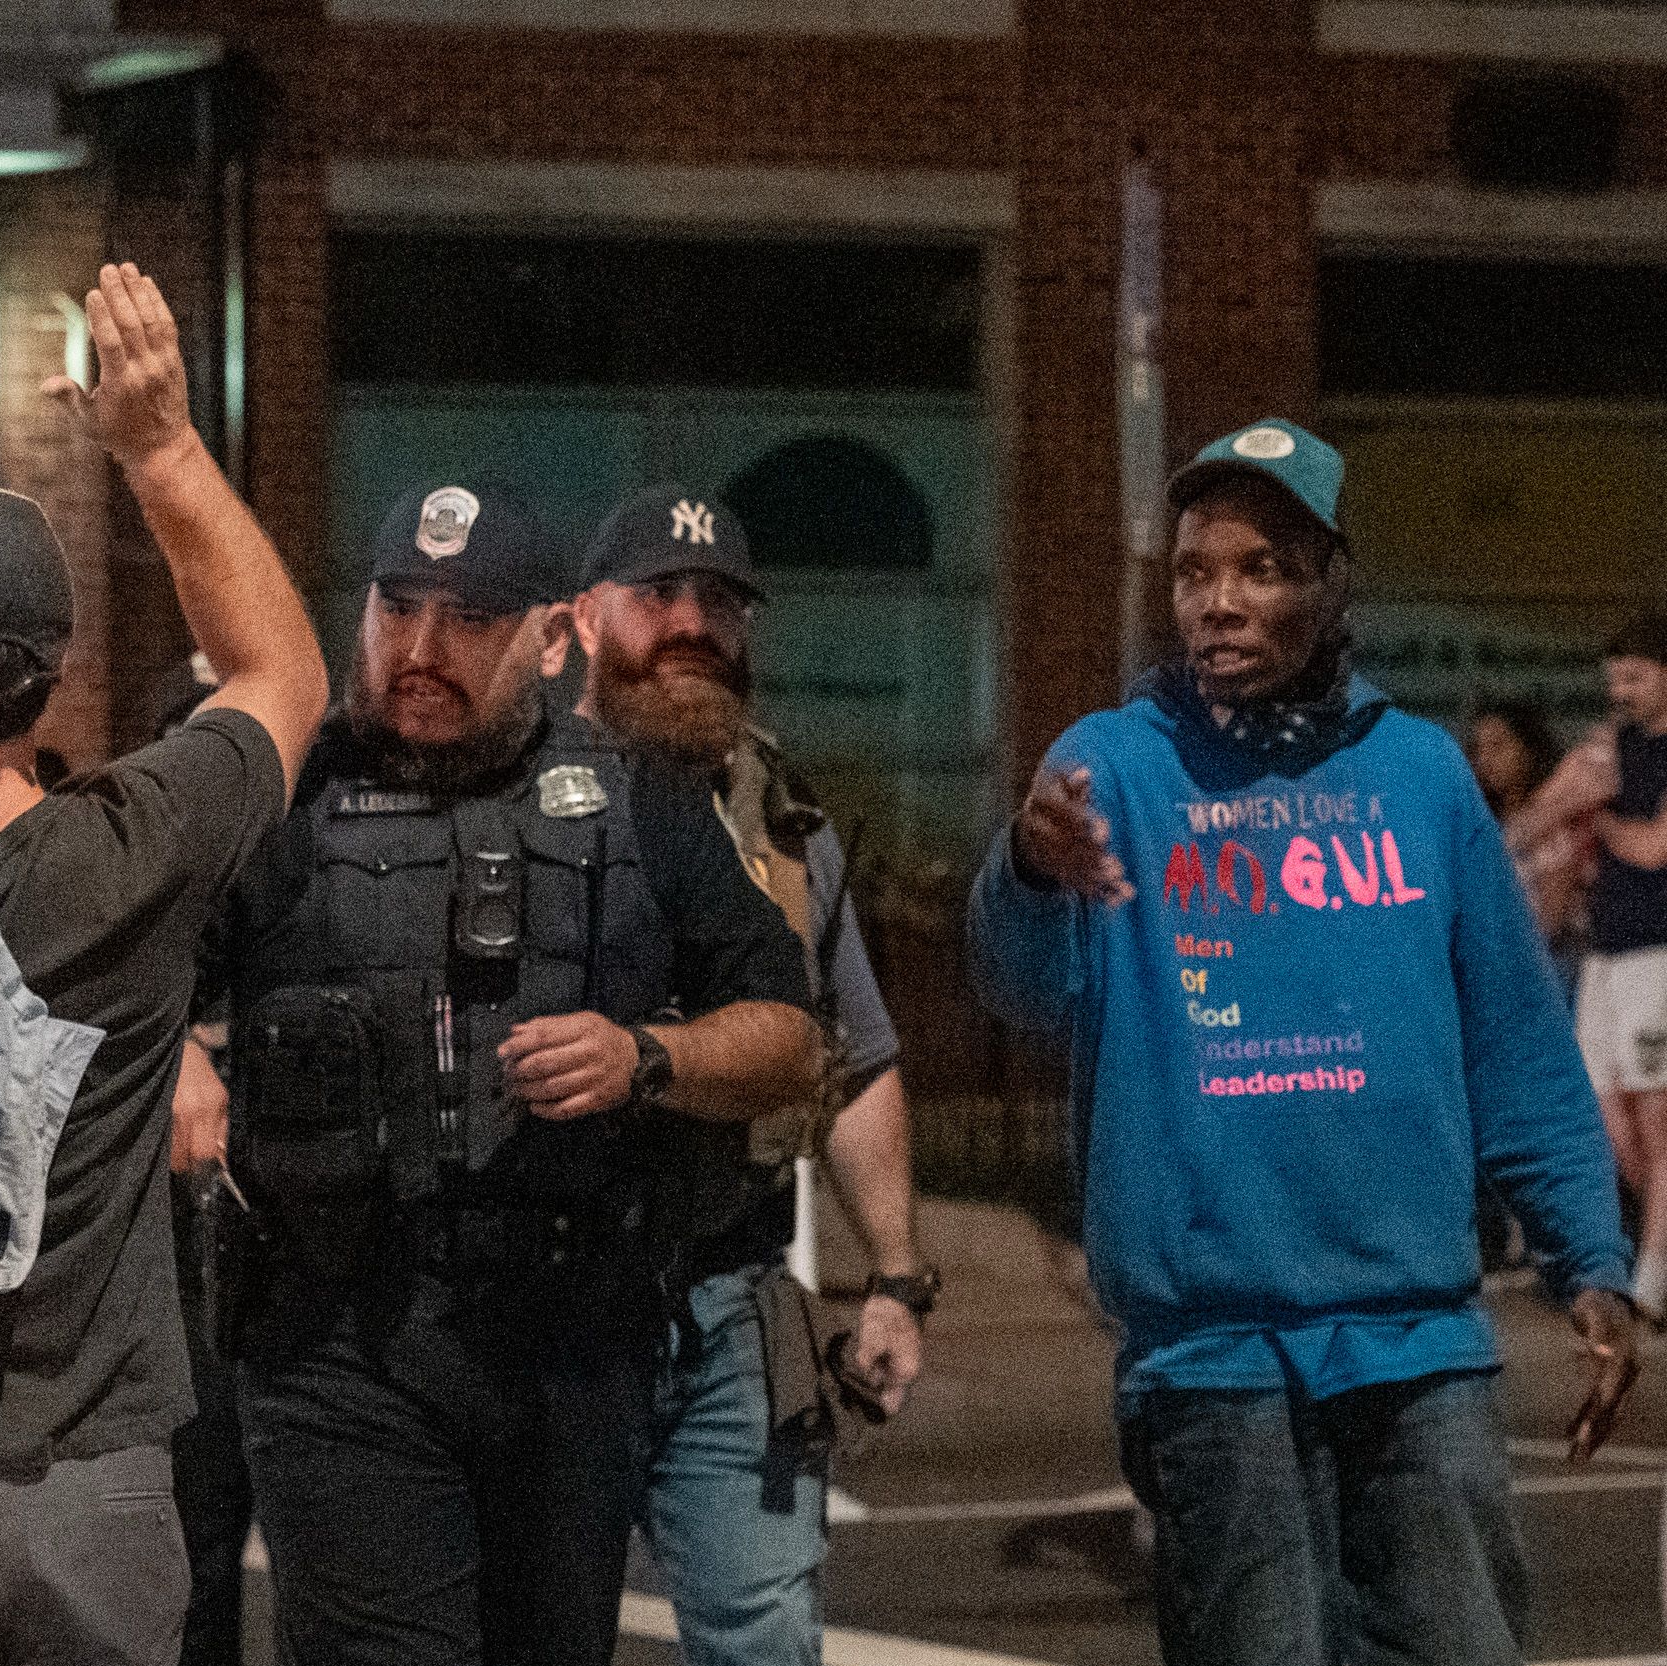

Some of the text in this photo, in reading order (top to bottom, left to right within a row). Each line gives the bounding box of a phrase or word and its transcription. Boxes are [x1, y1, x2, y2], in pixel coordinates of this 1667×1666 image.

[1186, 797, 1291, 834] WOMEN
[1297, 791, 1359, 829] LOVE
[1199, 1030, 1364, 1060] nderstand
[1198, 1066, 1366, 1096] Leadership
